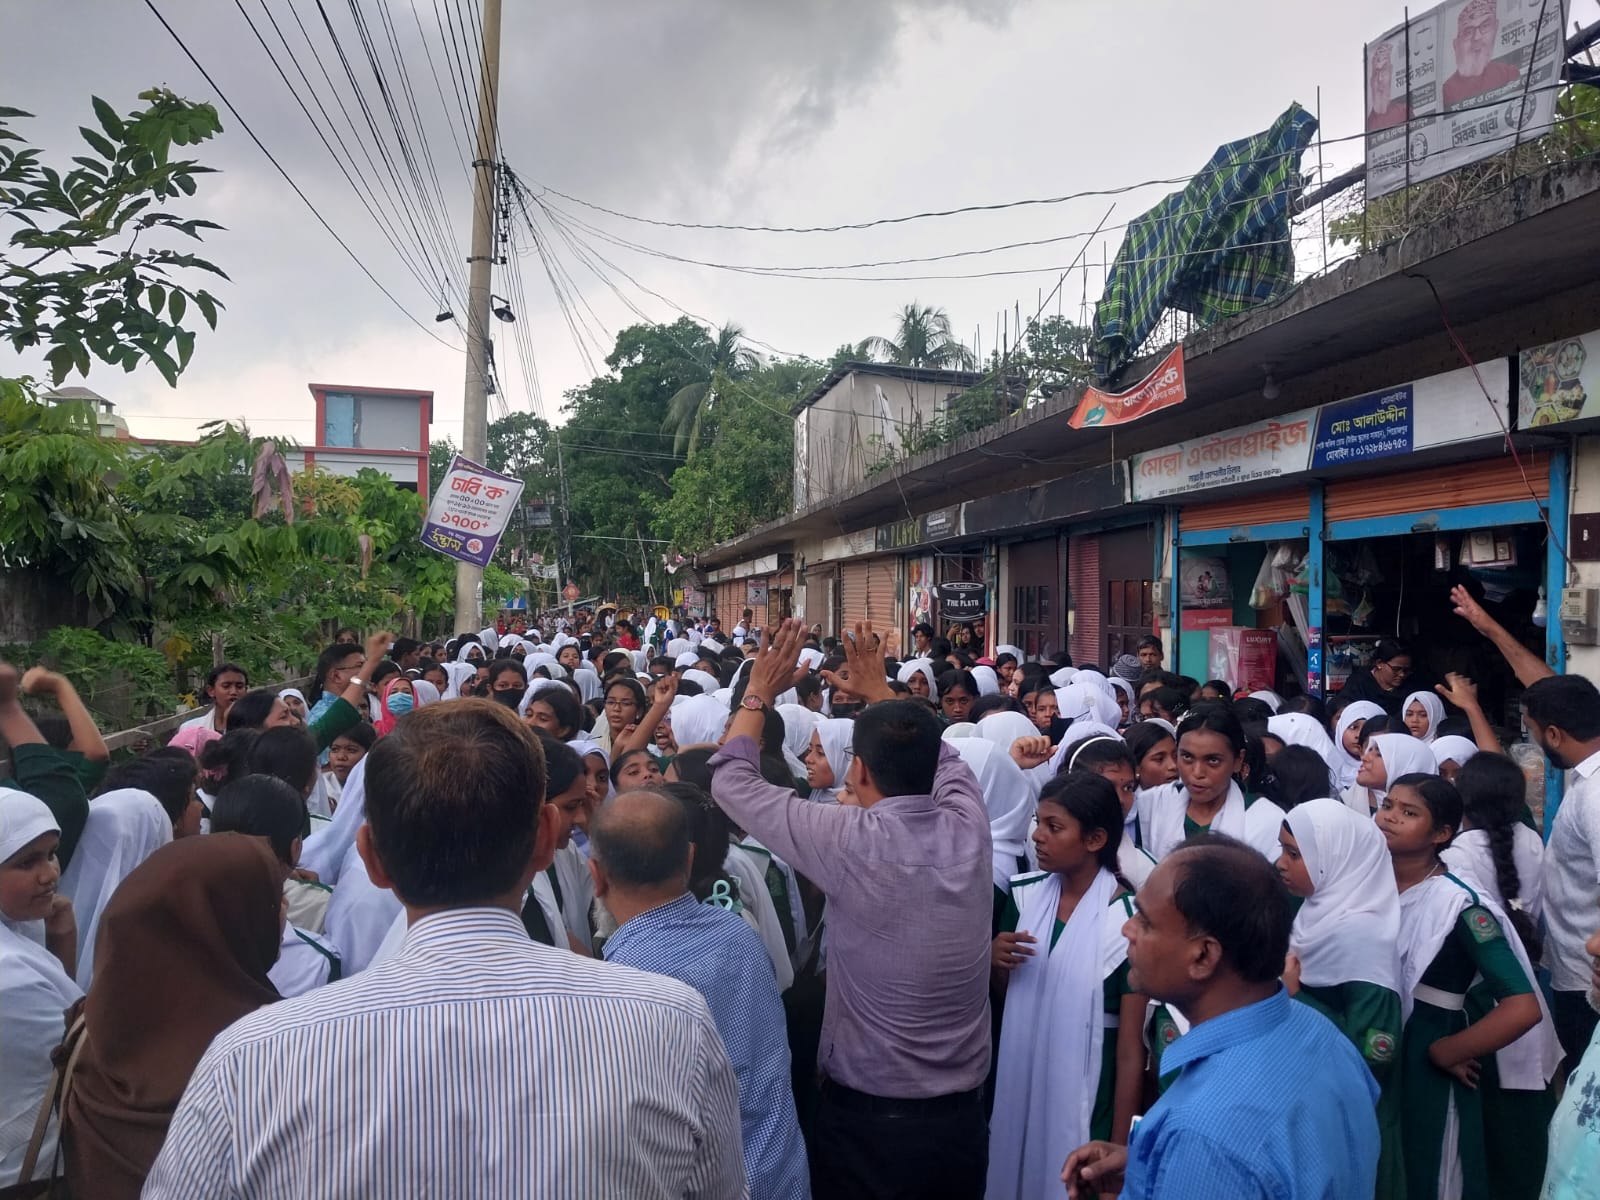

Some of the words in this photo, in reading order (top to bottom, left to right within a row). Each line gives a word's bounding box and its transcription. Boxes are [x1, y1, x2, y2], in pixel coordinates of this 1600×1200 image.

[1331, 420, 1351, 435] মোঃ
[1140, 451, 1184, 479] মোল্লা
[1187, 419, 1309, 465] এন্টারপ্রাইজ
[1326, 446, 1349, 461] মোবাইল
[451, 476, 483, 496] ঢাবি
[441, 512, 489, 532] ১৭০০+
[947, 599, 959, 607] THE
[1246, 635, 1272, 643] LUXURY
